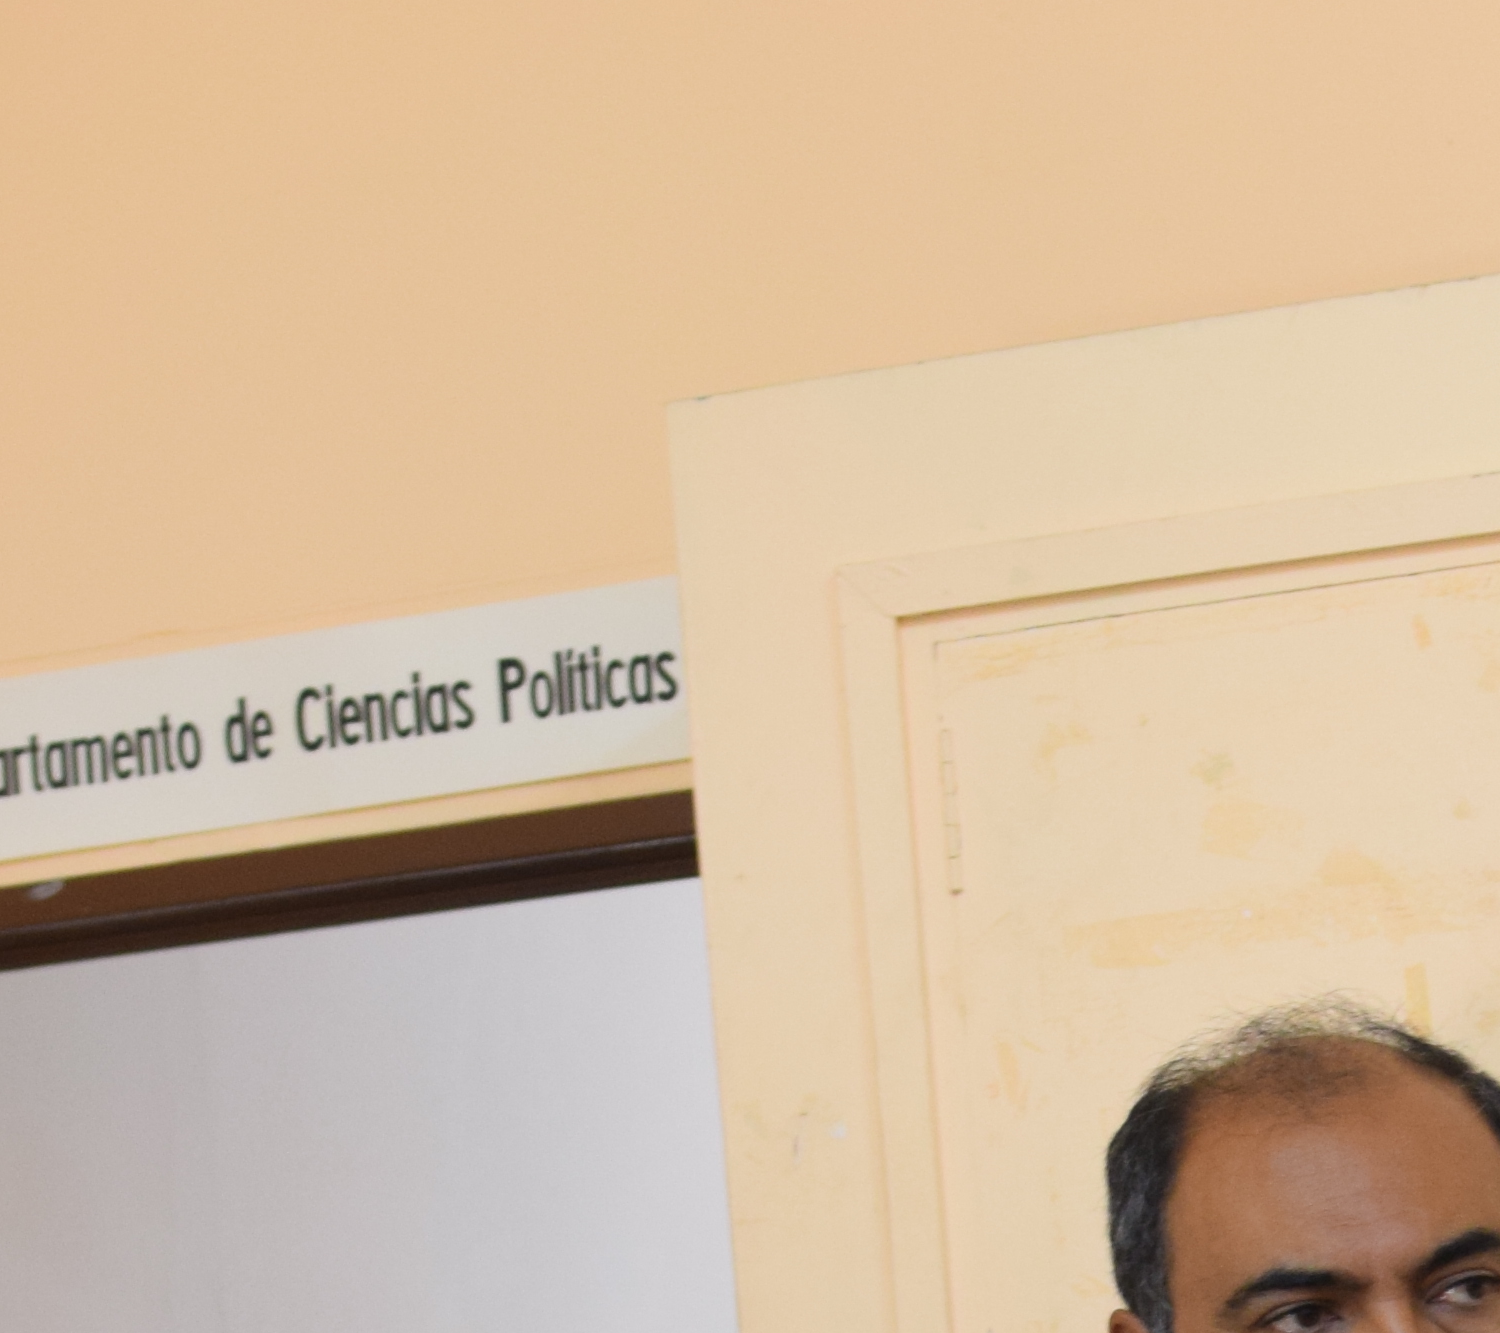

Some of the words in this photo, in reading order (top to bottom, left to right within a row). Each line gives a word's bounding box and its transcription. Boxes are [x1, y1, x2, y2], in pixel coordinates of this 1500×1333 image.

[225, 697, 274, 764] de
[296, 672, 476, 752] Ciencias
[497, 645, 680, 723] Políticas
